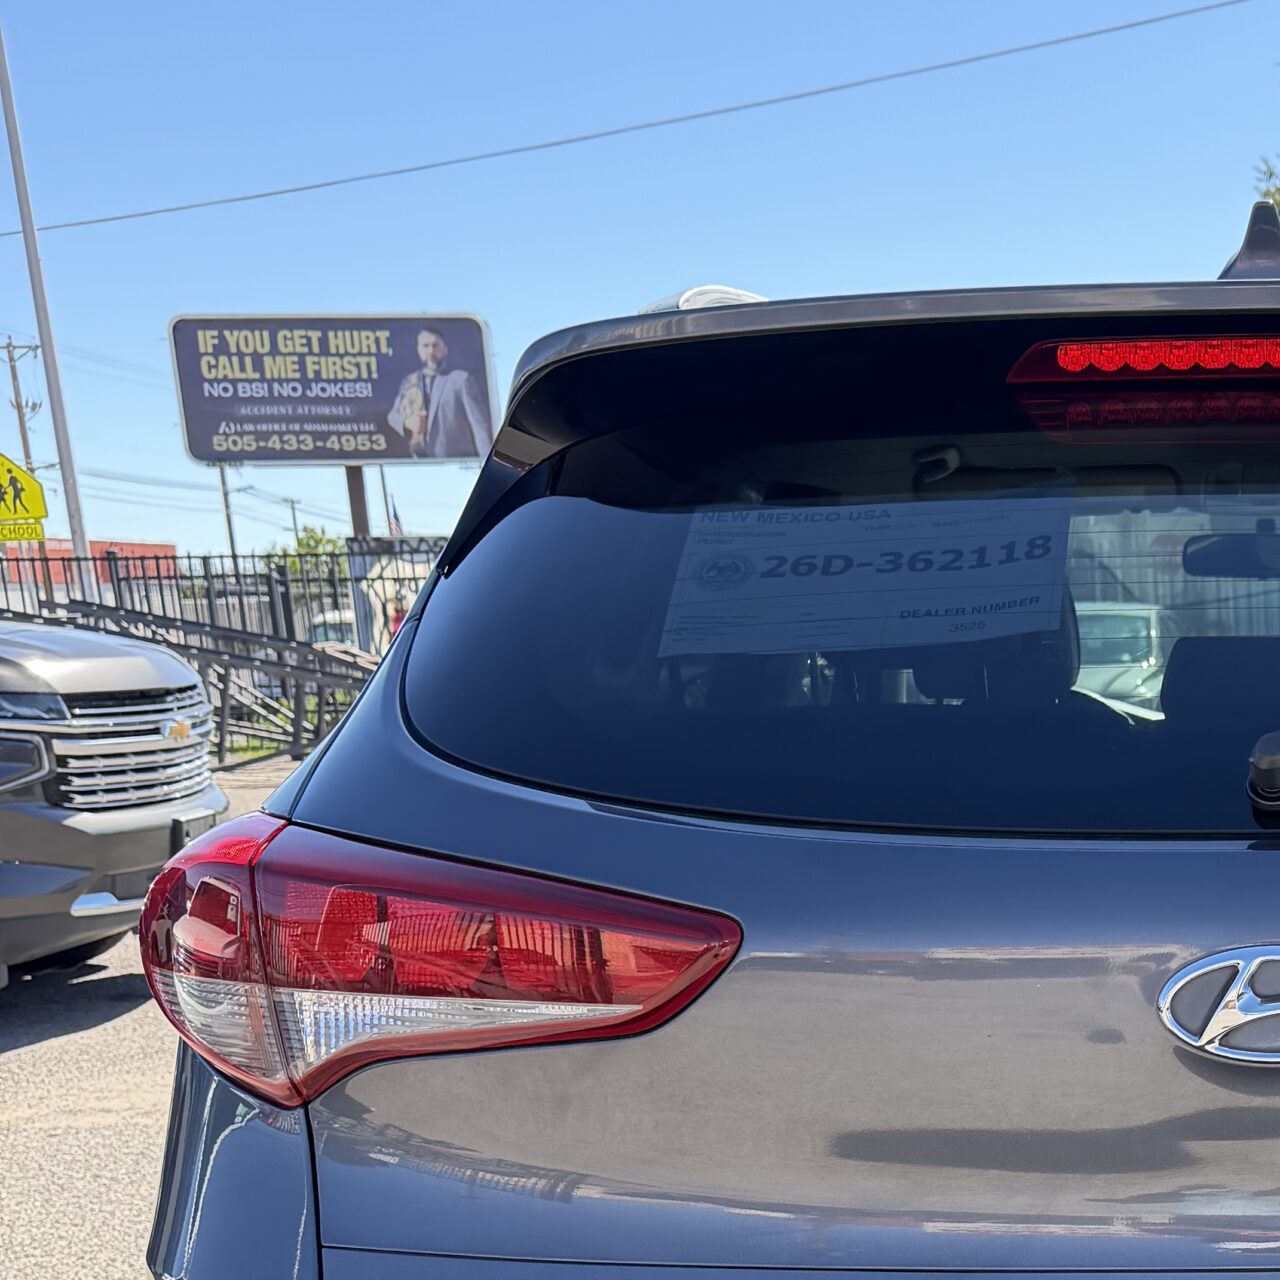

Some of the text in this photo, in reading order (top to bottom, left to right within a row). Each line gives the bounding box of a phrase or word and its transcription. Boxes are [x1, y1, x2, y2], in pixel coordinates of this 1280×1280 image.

[197, 329, 393, 357] IF YOU GET HURT,
[200, 355, 379, 380] CALL ME FIRST!
[203, 382, 373, 398] NO BS! NO JOKES!
[297, 405, 352, 416] ATTORNEY
[212, 434, 388, 452] 505-433-4953
[701, 508, 892, 524] NEW MEXICO USA
[0, 526, 41, 538] CHOOL
[759, 535, 1052, 578] 26D-362118
[900, 596, 1041, 619] DEALER NUMBER
